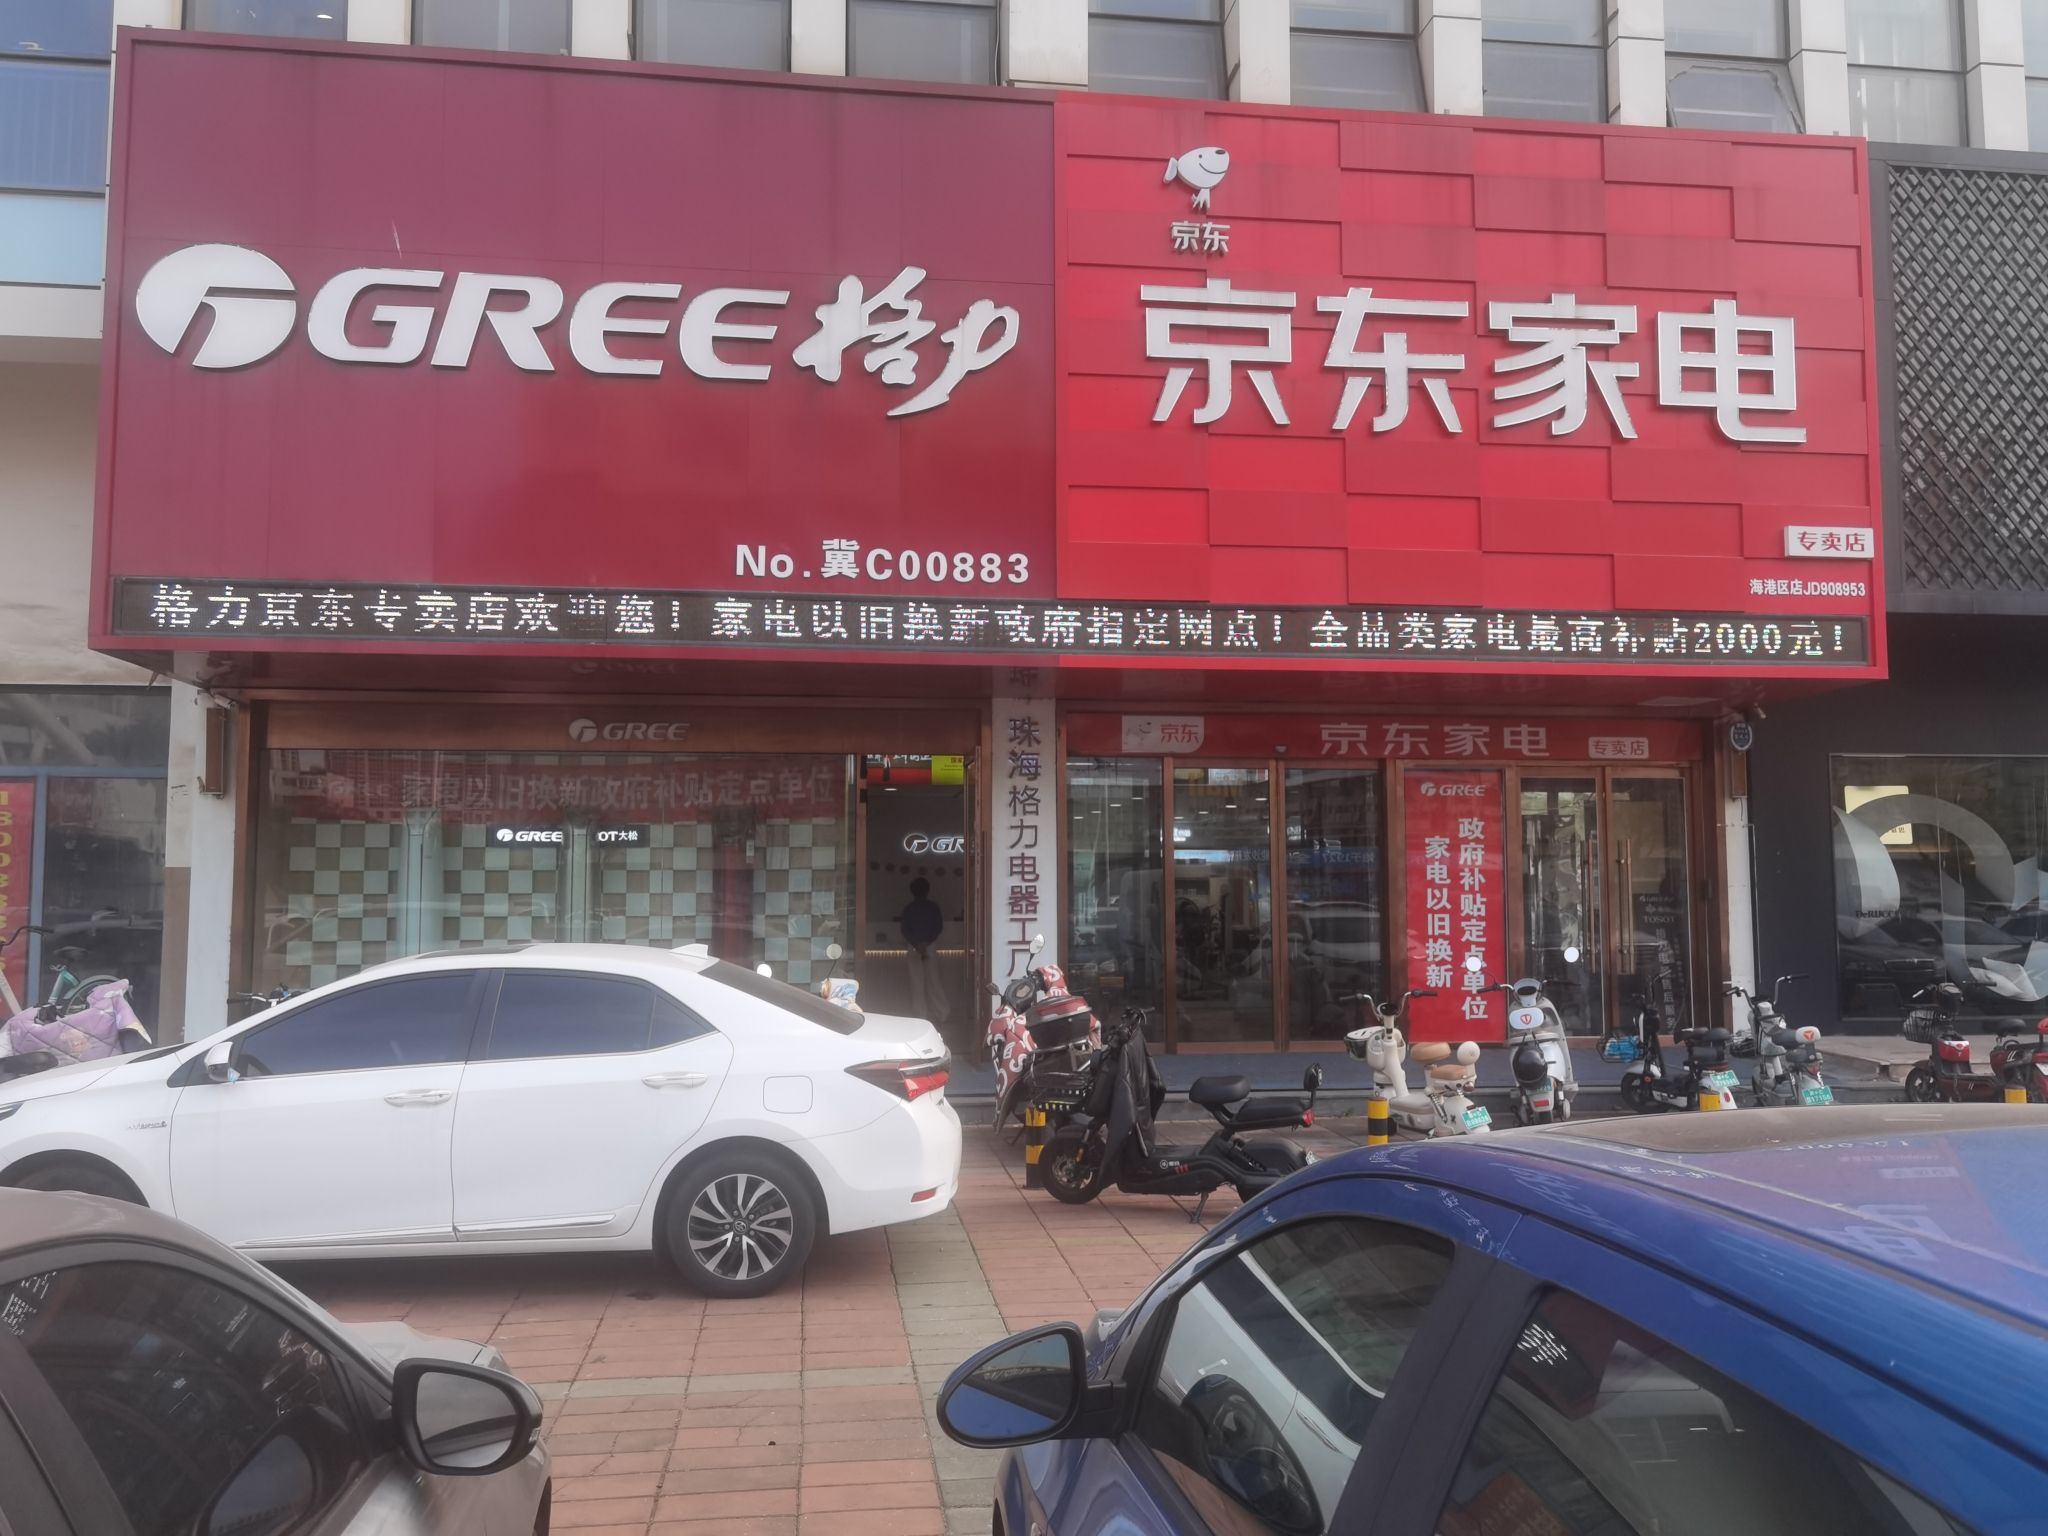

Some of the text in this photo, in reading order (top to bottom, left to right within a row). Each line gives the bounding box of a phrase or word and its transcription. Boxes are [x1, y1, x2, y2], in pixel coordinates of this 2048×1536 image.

[1171, 220, 1230, 254] 京东
[307, 267, 790, 382] GREE
[1140, 277, 1808, 444] 京东家电
[1796, 531, 1866, 552] 专卖店
[1749, 577, 1867, 599] 海港区店JD908953
[602, 721, 690, 741] GREE
[1159, 722, 1200, 744] 京东
[1319, 721, 1551, 758] 京东家电
[1591, 739, 1646, 758] 专卖店
[1438, 783, 1486, 797] GREE
[515, 831, 563, 842] GREE
[1424, 835, 1454, 989] 家电以旧换新
[1457, 816, 1489, 1021] 政府补贴定点单位
